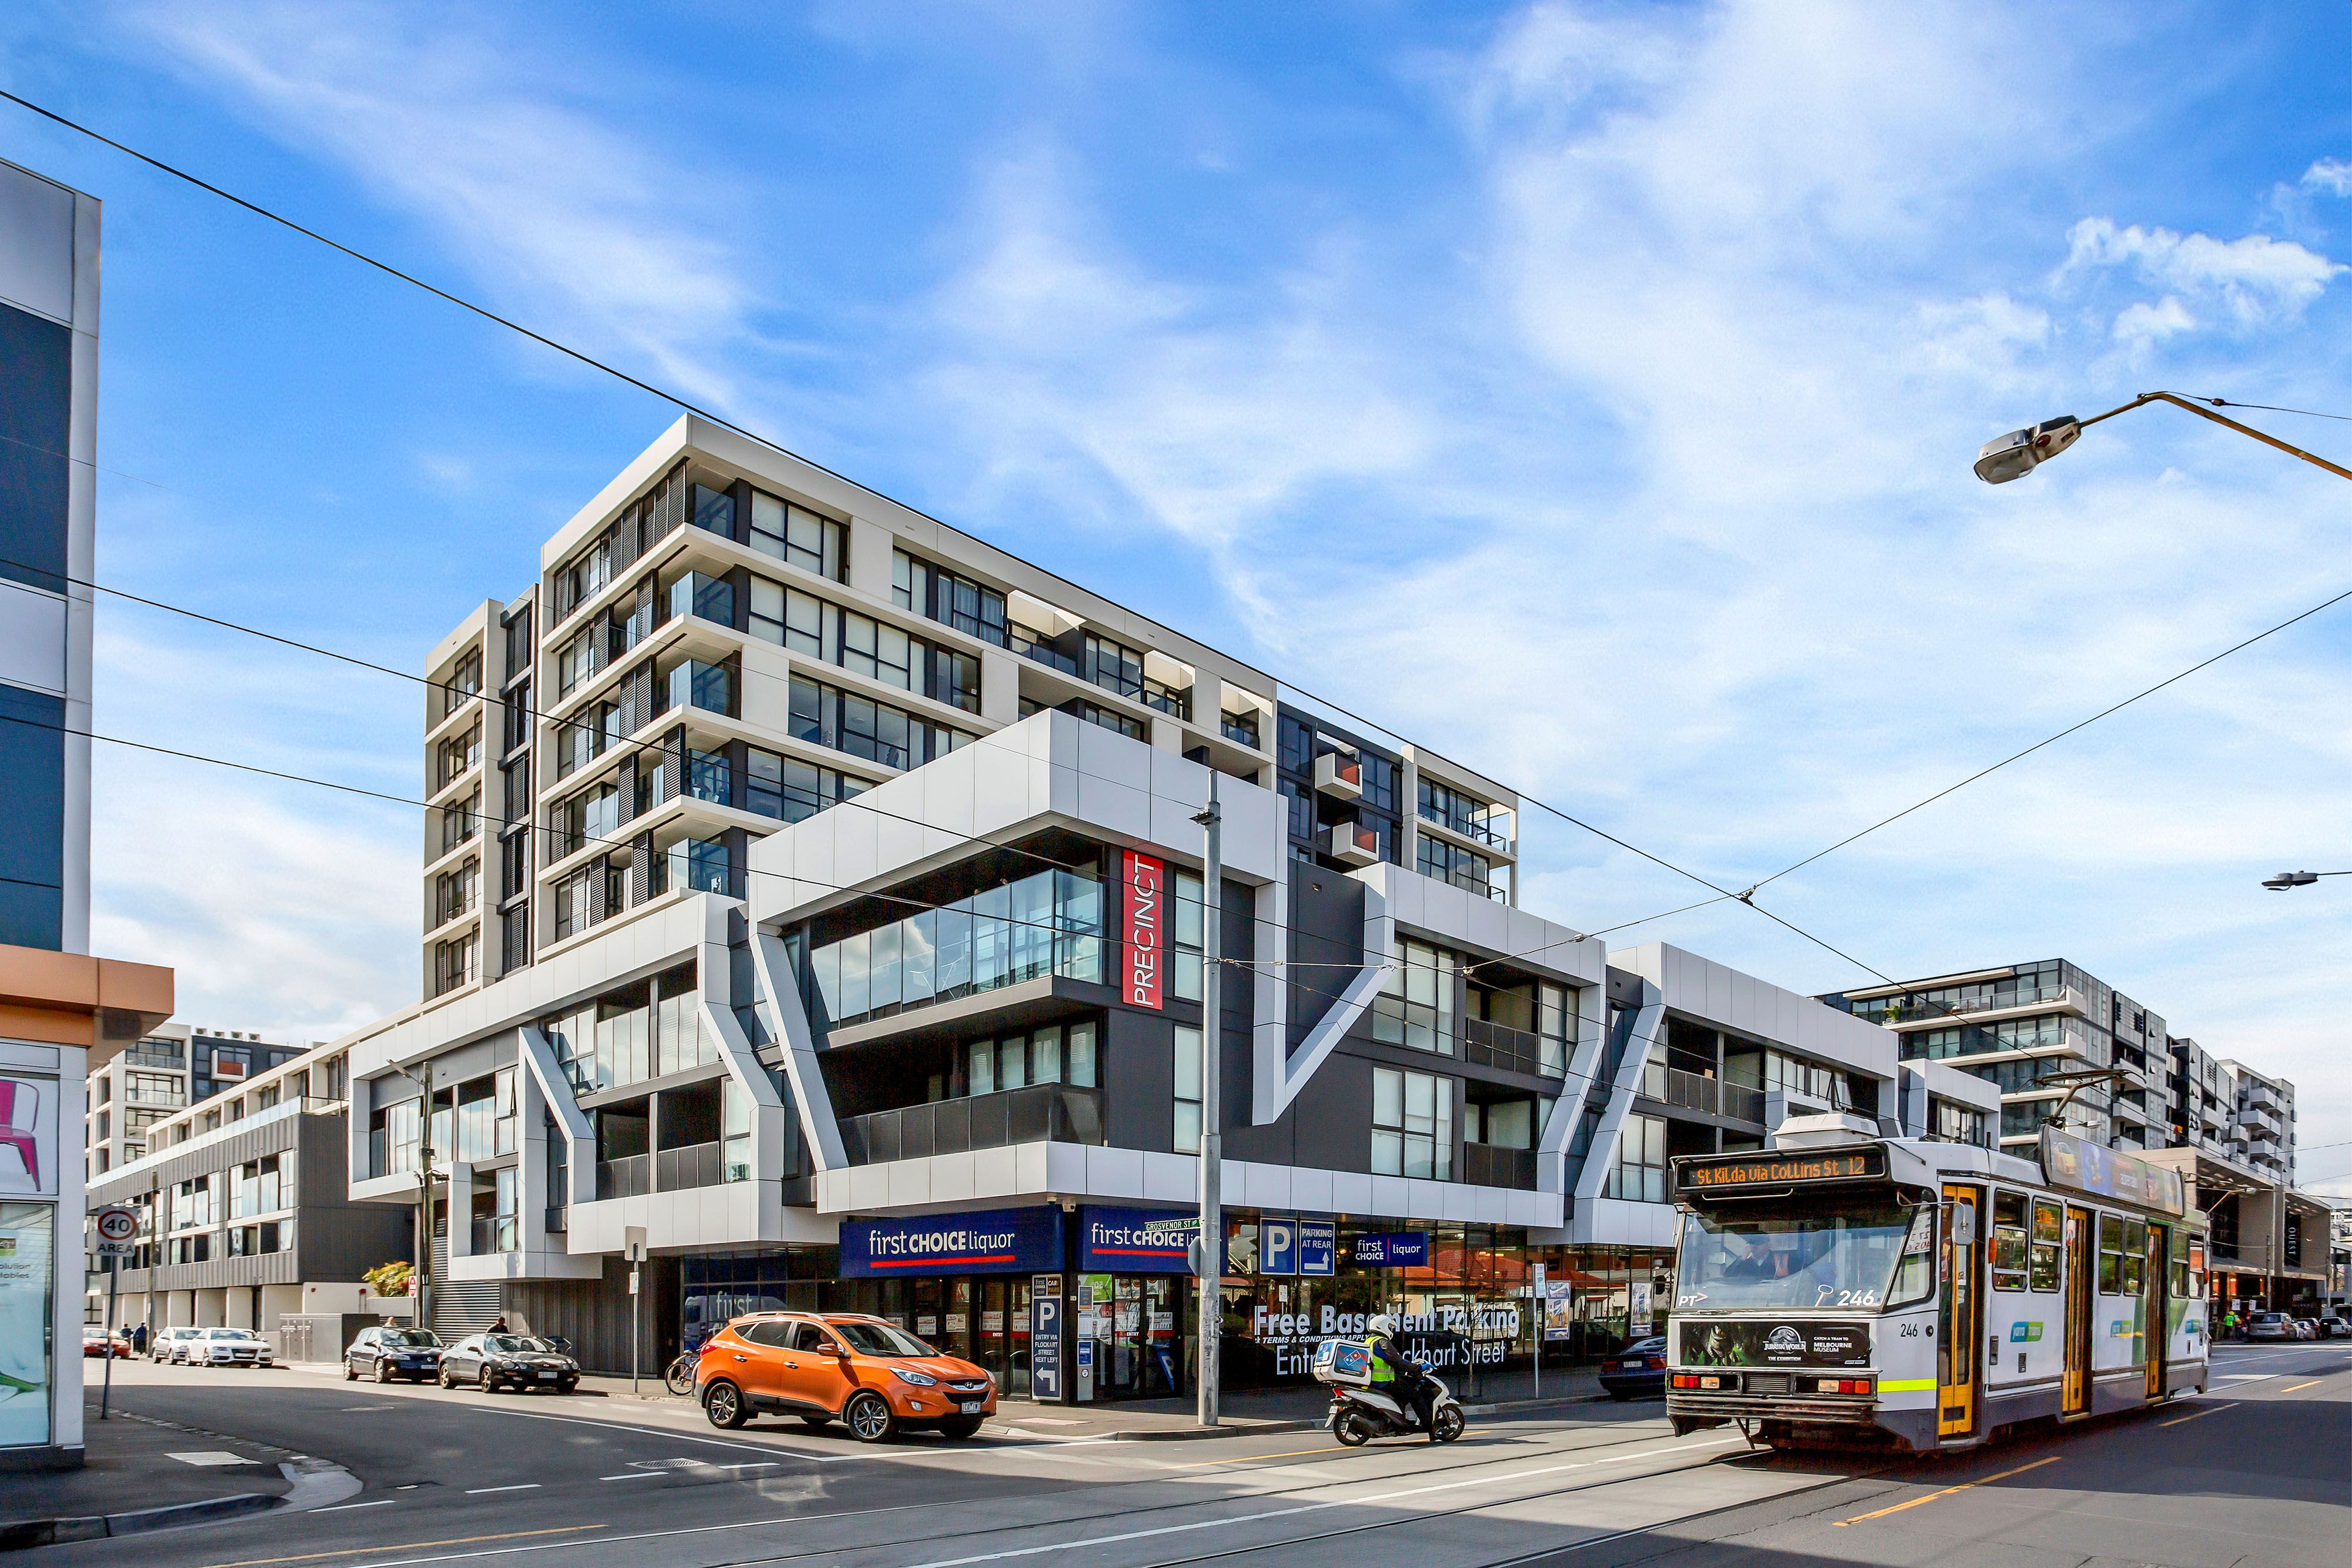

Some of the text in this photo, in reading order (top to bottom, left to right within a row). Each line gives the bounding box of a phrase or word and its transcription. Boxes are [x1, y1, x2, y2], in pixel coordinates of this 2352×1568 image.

[1134, 854, 1156, 1006] PRECINCT
[1697, 1156, 1865, 1185] St Kilda via Collins St 12
[104, 1219, 130, 1232] 40
[1091, 1223, 1131, 1244] first
[1132, 1231, 1184, 1247] CHOICE
[1146, 1220, 1191, 1231] GROSVENOR ST
[1302, 1228, 1332, 1238] PARKING
[97, 1243, 133, 1253] AREA
[869, 1230, 1015, 1255] first CHOICE liquor
[1268, 1225, 1291, 1267] P
[1312, 1240, 1331, 1249] REAR
[1358, 1240, 1382, 1252] first
[1393, 1243, 1421, 1255] liquor
[716, 1290, 753, 1318] first
[1837, 1289, 1875, 1306] 246
[1040, 1302, 1055, 1330] P
[1255, 1305, 1310, 1335] Free
[1900, 1323, 1918, 1338] 246
[1277, 1338, 1506, 1375] Entr ckhart Street
